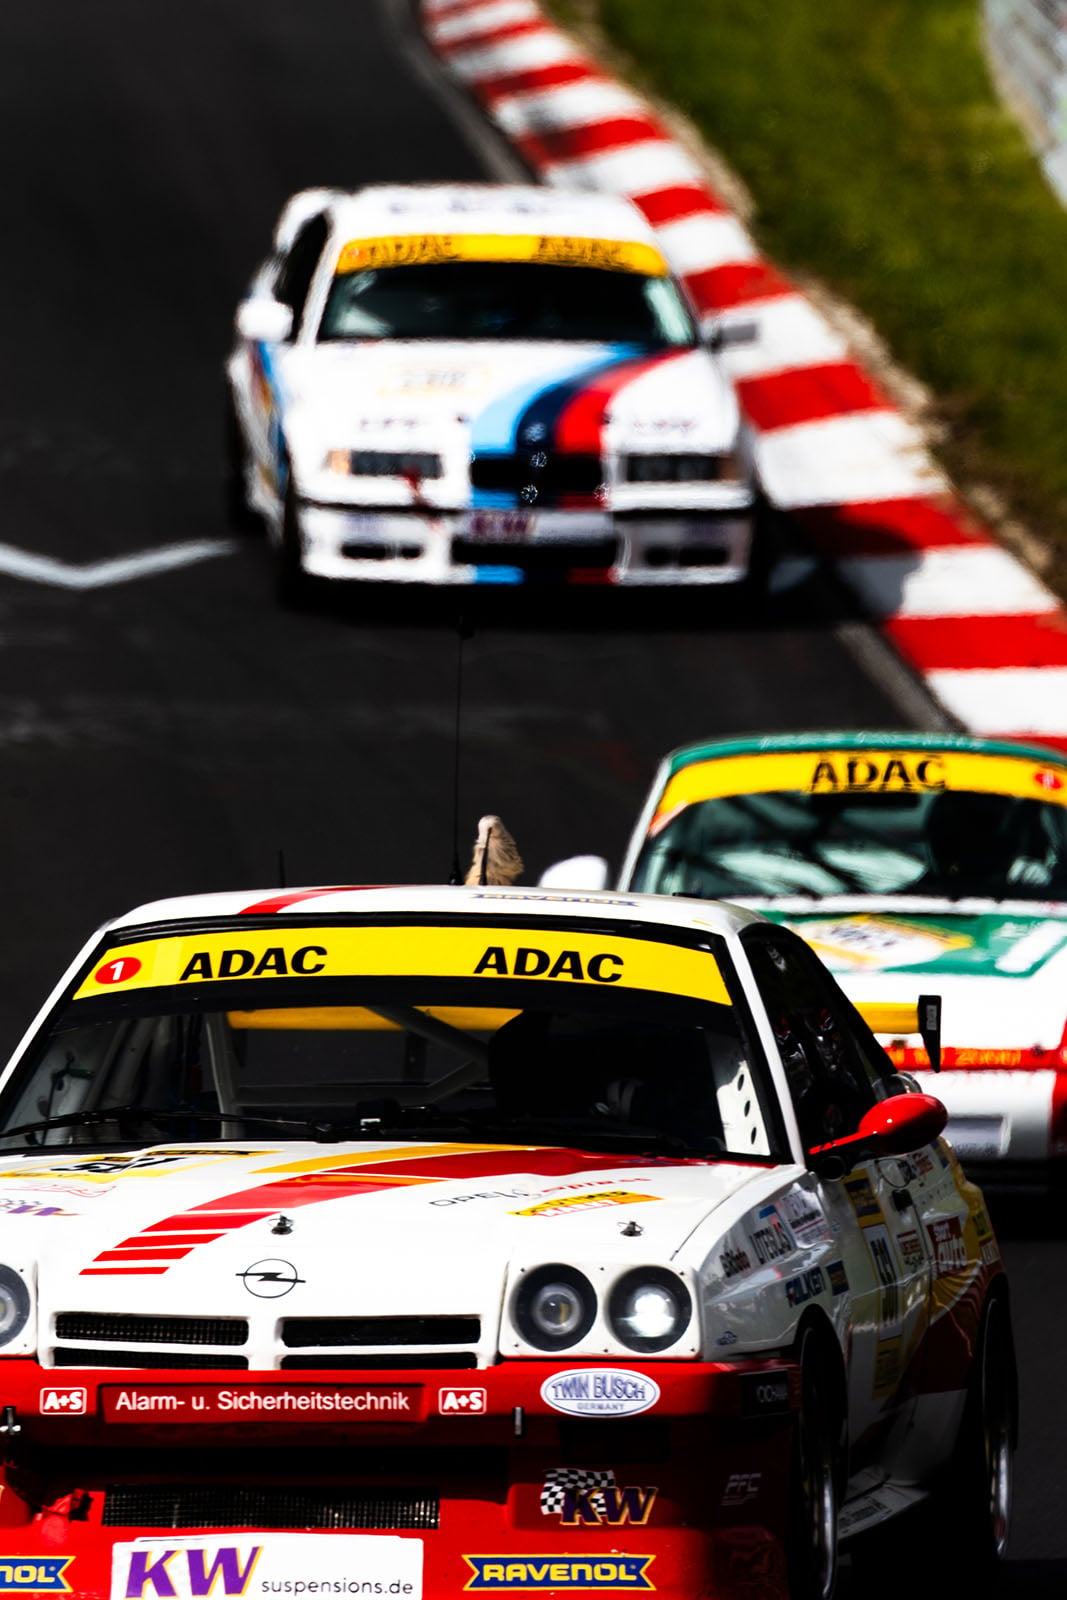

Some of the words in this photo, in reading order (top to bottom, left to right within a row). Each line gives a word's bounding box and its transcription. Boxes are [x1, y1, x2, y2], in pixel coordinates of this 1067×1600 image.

[809, 755, 946, 792] ADAC
[109, 961, 124, 982] 1
[179, 946, 327, 981] ADAC
[474, 946, 624, 982] ADAC
[551, 1375, 590, 1401] TWIN
[593, 1374, 648, 1401] BUSCH
[43, 1391, 83, 1411] A+S
[115, 1391, 185, 1411] Alarm-
[192, 1395, 210, 1410] u.
[217, 1391, 410, 1411] Sicherheitstechnik
[443, 1391, 483, 1411] A+S
[577, 1401, 625, 1412] GERMANY
[560, 1486, 658, 1526] KW
[125, 1545, 264, 1599] KW
[482, 1563, 639, 1582] RAVENOL
[261, 1579, 414, 1598] suspensions.de
